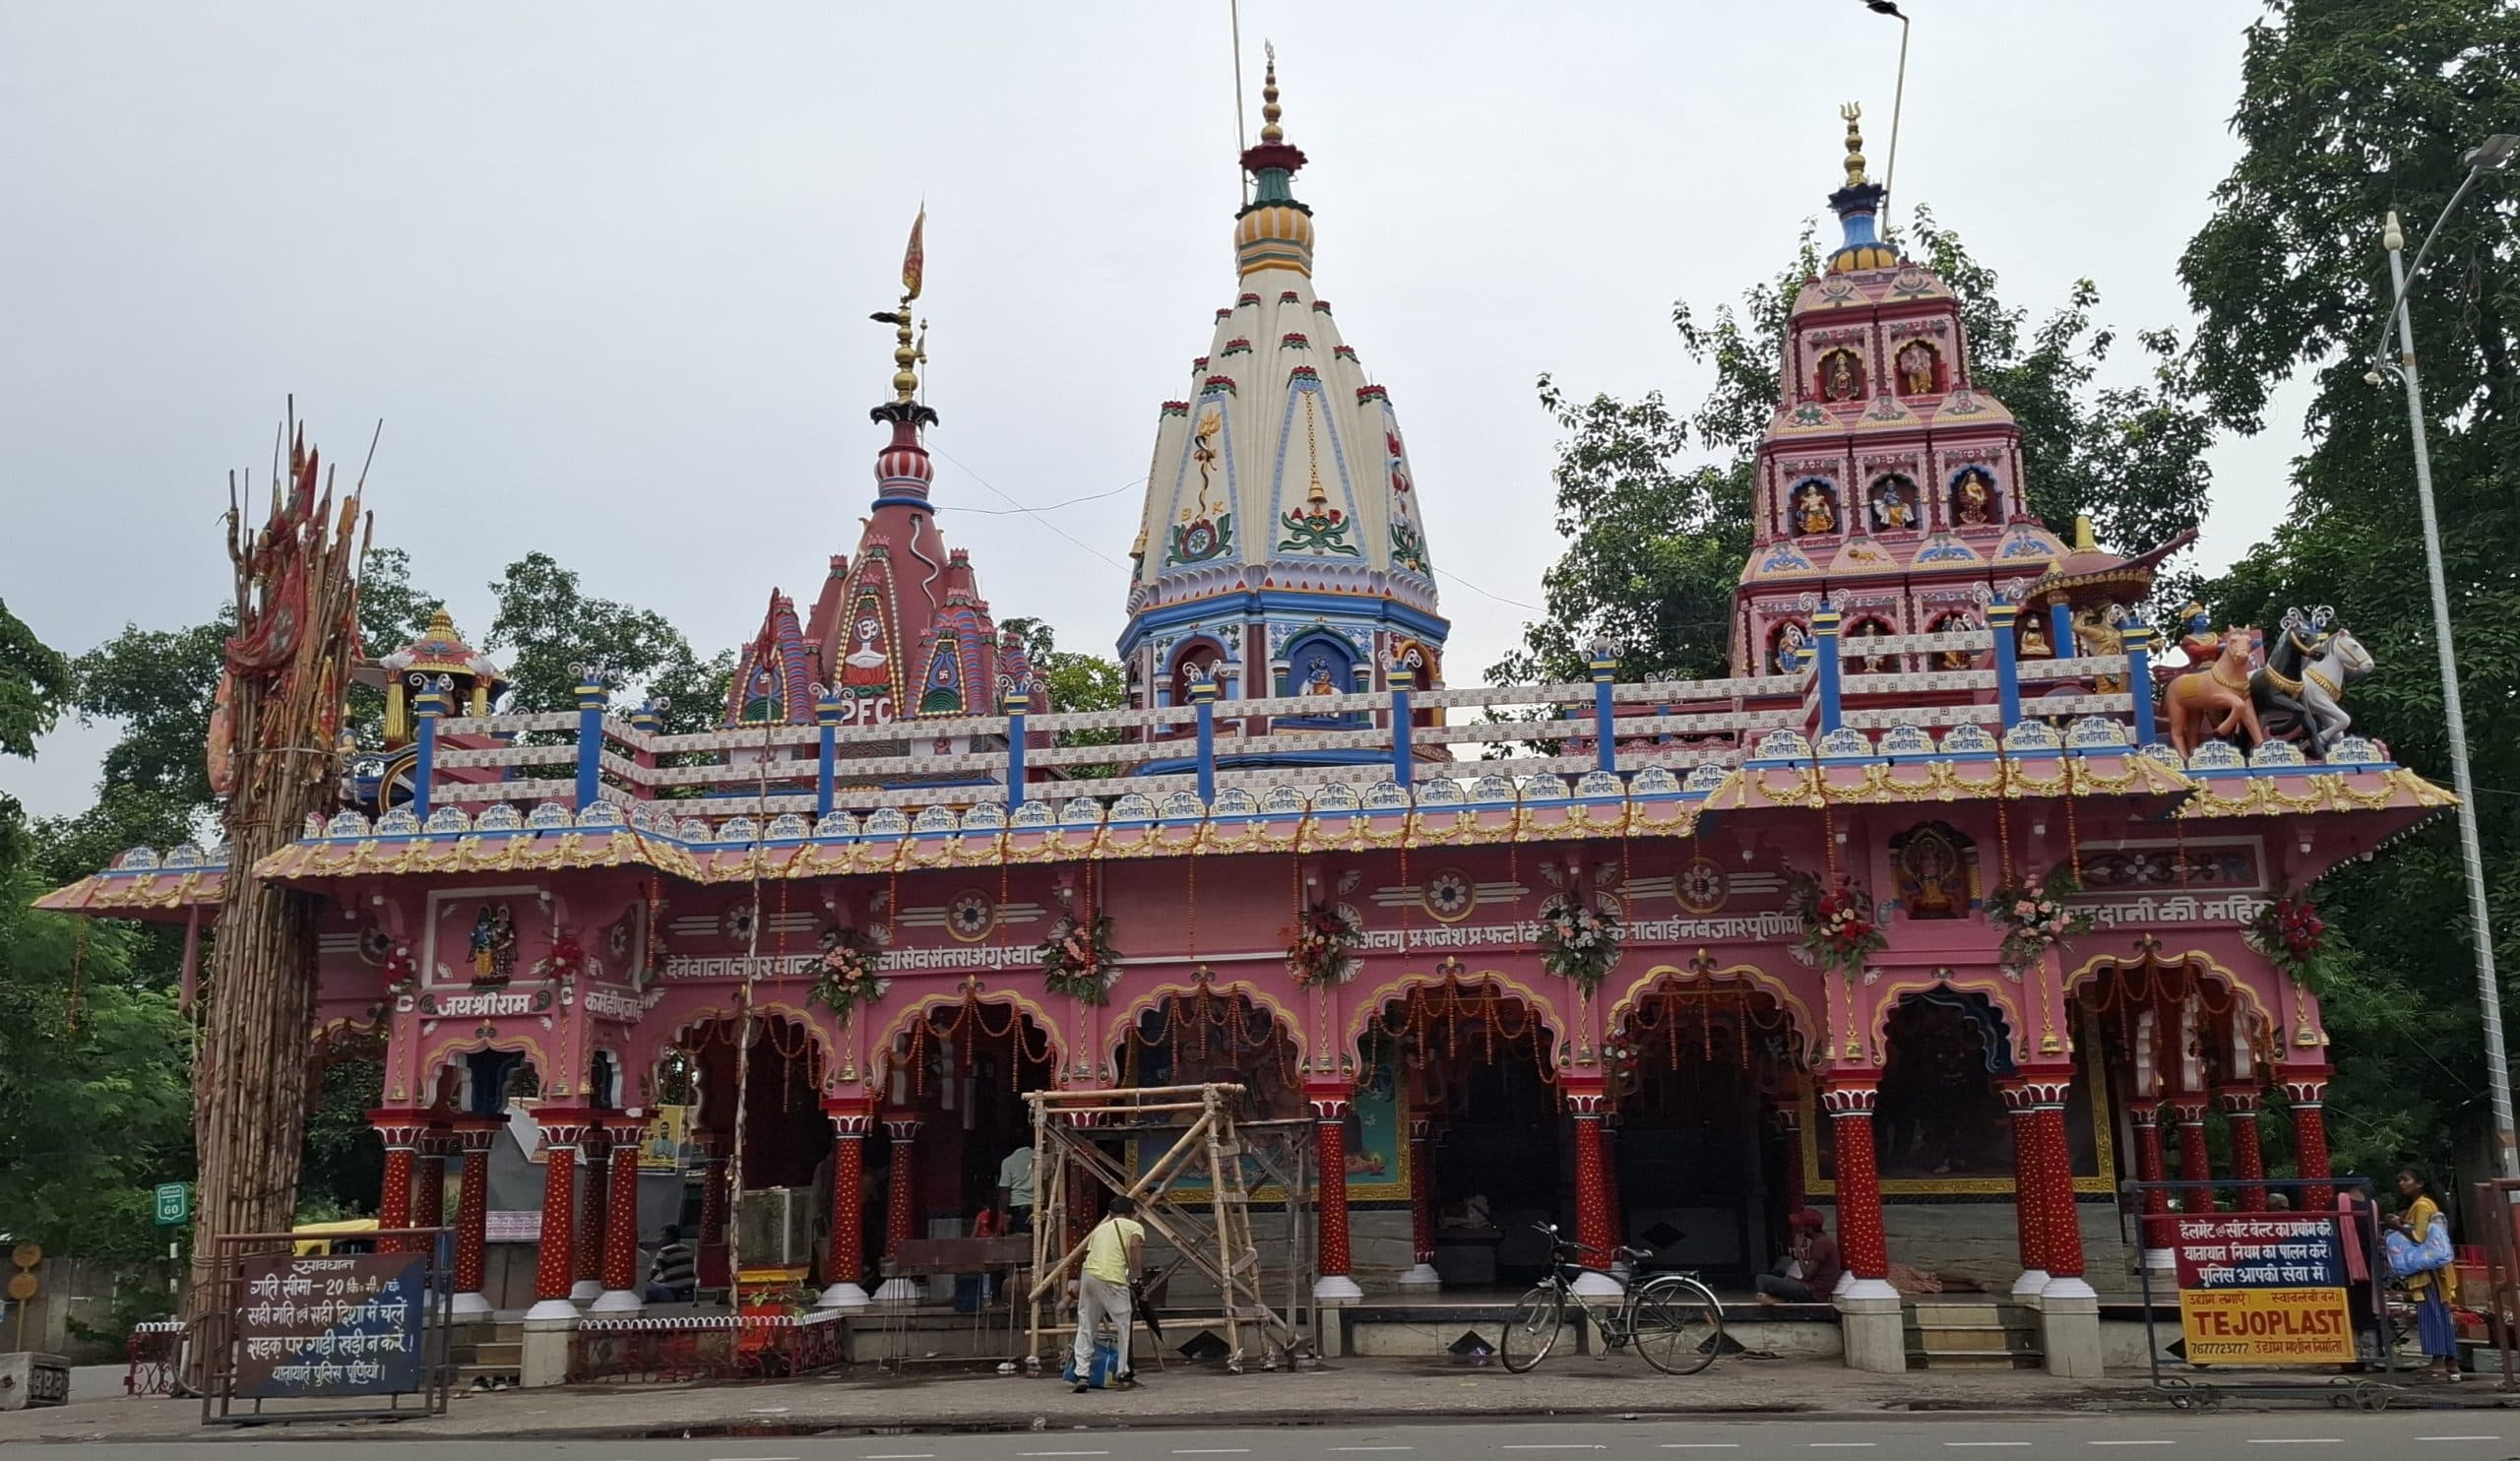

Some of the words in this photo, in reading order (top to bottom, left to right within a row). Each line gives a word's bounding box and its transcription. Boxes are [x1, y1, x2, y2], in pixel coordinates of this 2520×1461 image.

[164, 1204, 178, 1215] 60
[2178, 1219, 2215, 1239] हेलमेट
[2274, 1223, 2289, 1238] का
[2182, 1245, 2227, 1261] यातायात
[2230, 1241, 2260, 1260] नियम
[2262, 1244, 2277, 1259] का
[2278, 1244, 2307, 1259] पालन
[250, 1273, 280, 1301] गति
[283, 1274, 312, 1299] सीमा
[326, 1279, 344, 1295] 20
[2197, 1263, 2235, 1288] पुलिस
[2236, 1263, 2279, 1283] आपकी
[2279, 1262, 2309, 1283] सेवा
[248, 1301, 271, 1326] सही
[272, 1301, 295, 1327] गति
[310, 1300, 335, 1326] सही
[336, 1299, 365, 1327] दिशा
[366, 1299, 379, 1323] में
[380, 1297, 409, 1325] चलें
[2192, 1309, 2344, 1336] TEJOPLAST
[284, 1337, 305, 1356] पर
[367, 1335, 379, 1353] न
[313, 1361, 344, 1387] पुलिस
